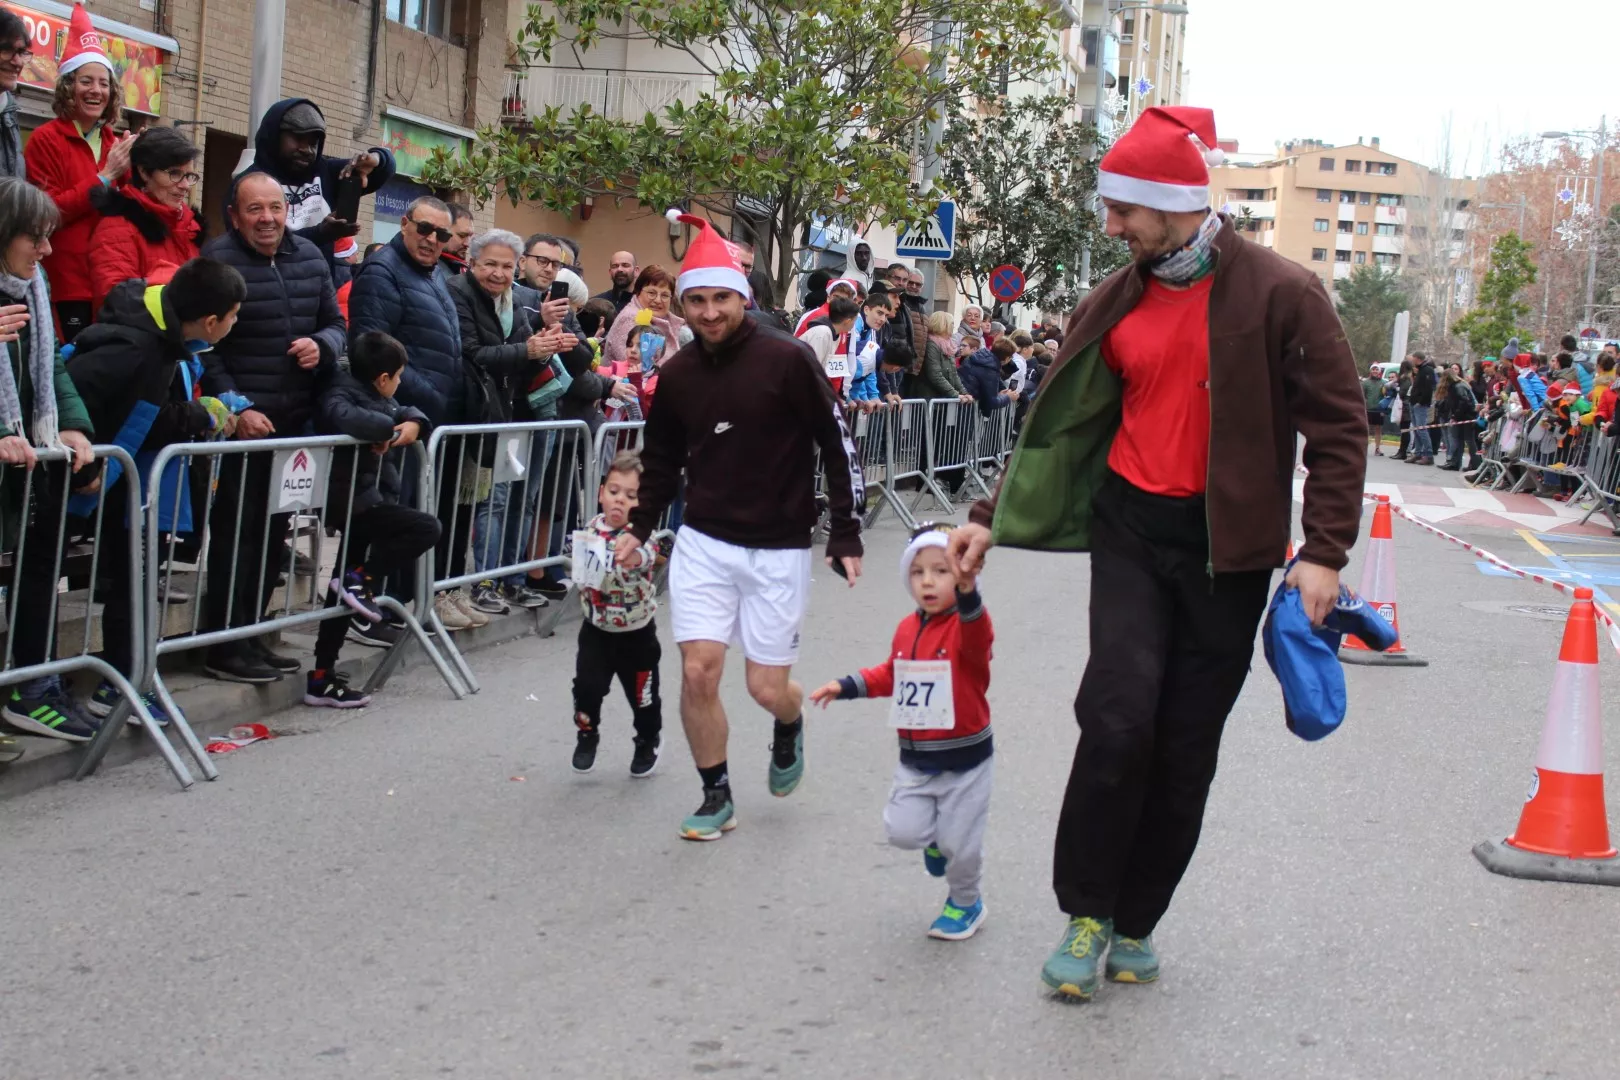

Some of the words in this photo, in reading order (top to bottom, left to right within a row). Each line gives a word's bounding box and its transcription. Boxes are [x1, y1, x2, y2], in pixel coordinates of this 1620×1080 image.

[20, 14, 50, 46] DO
[828, 361, 844, 371] 325
[283, 478, 312, 490] ALCO
